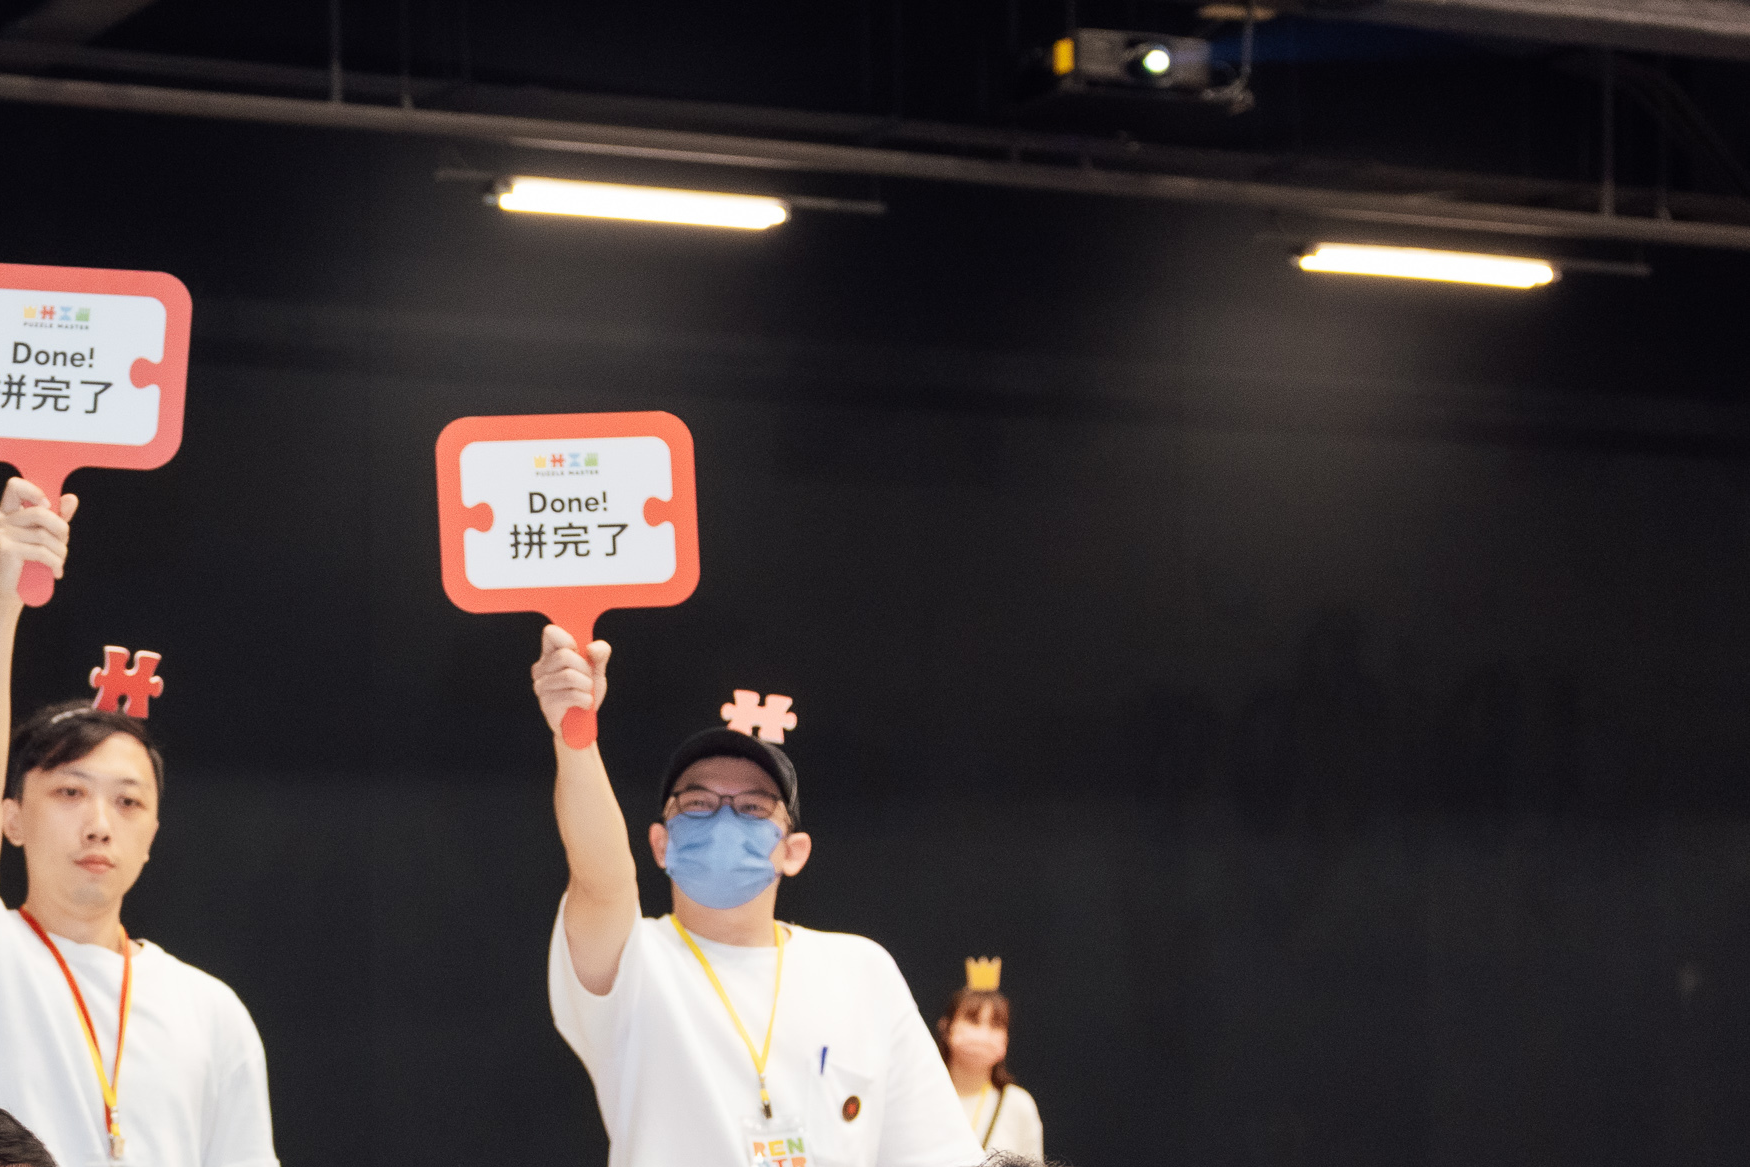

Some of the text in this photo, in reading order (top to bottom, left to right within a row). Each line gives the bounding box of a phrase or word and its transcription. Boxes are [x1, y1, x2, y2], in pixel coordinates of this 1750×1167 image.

[12, 341, 95, 369] Done!
[528, 491, 608, 514] Done!
[509, 522, 629, 559] 拼完了
[753, 1137, 805, 1157] REN
